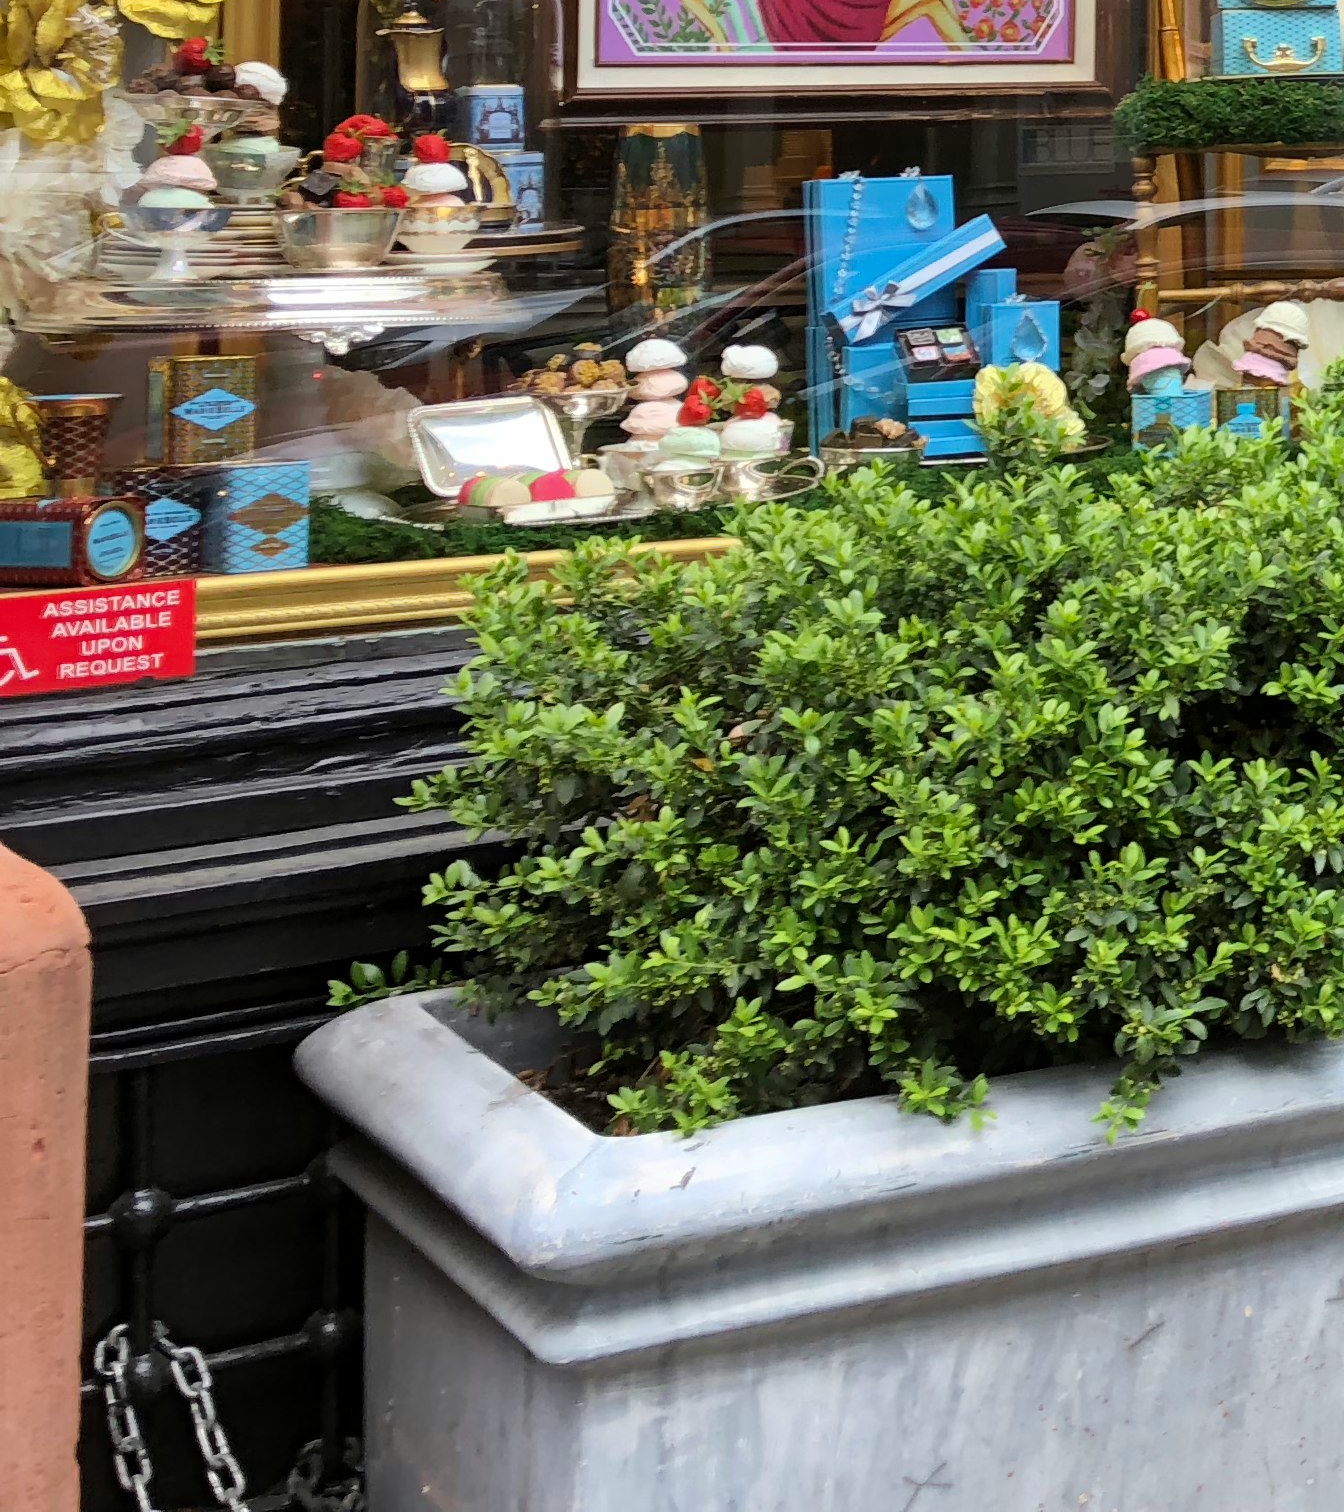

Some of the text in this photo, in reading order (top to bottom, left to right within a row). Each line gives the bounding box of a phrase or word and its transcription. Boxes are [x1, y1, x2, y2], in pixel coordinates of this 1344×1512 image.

[41, 590, 180, 619] ASSISTANCE
[51, 611, 172, 638] AVAILABLE
[80, 635, 143, 656] UPON
[57, 653, 164, 680] REQUEST
